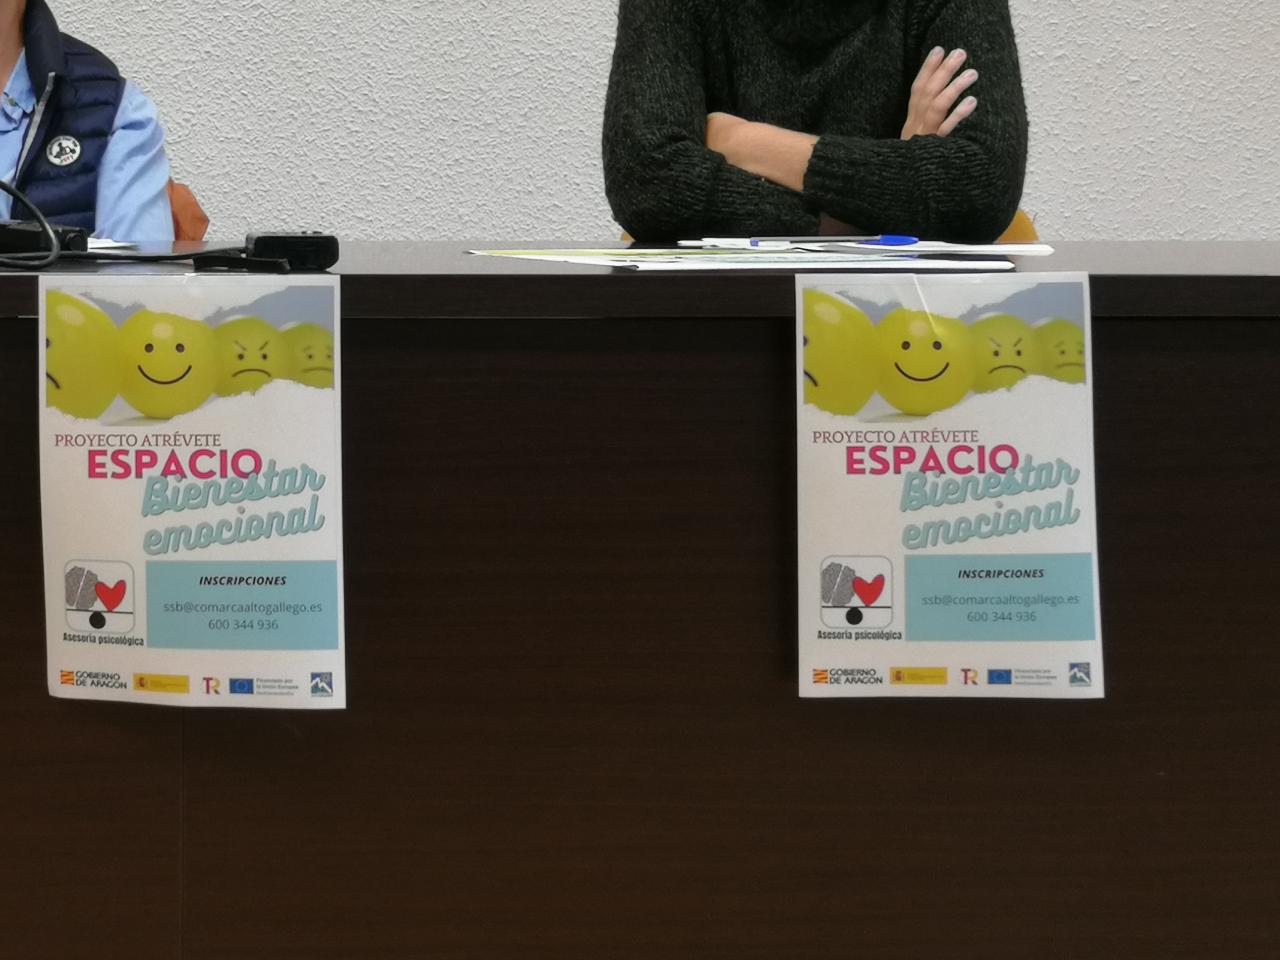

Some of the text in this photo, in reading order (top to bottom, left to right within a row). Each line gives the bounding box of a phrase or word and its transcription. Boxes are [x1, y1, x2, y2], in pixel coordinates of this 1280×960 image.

[54, 431, 222, 447] PROYECTO ATRÉVETE
[812, 427, 980, 443] PROYECTO ATRÉVETE
[88, 448, 263, 480] ESPACIO
[846, 444, 1019, 475] ESPACIO
[141, 458, 326, 517] Bienestar
[900, 453, 1081, 512] Bienestar
[142, 493, 325, 556] emocional
[901, 487, 1081, 550] emocional
[199, 576, 287, 586] INSCRIPCIONES
[958, 568, 1045, 579] INSCRIPCIONES
[163, 601, 322, 614] ssb@comarcaaltogallego.es
[922, 593, 1080, 608] ssb@comarcaaltogallego.es
[967, 611, 1037, 622] 600 344 936
[208, 619, 279, 631] 600 344 936
[75, 670, 121, 681] GOBIERNO
[829, 668, 877, 677] GOBIERNO
